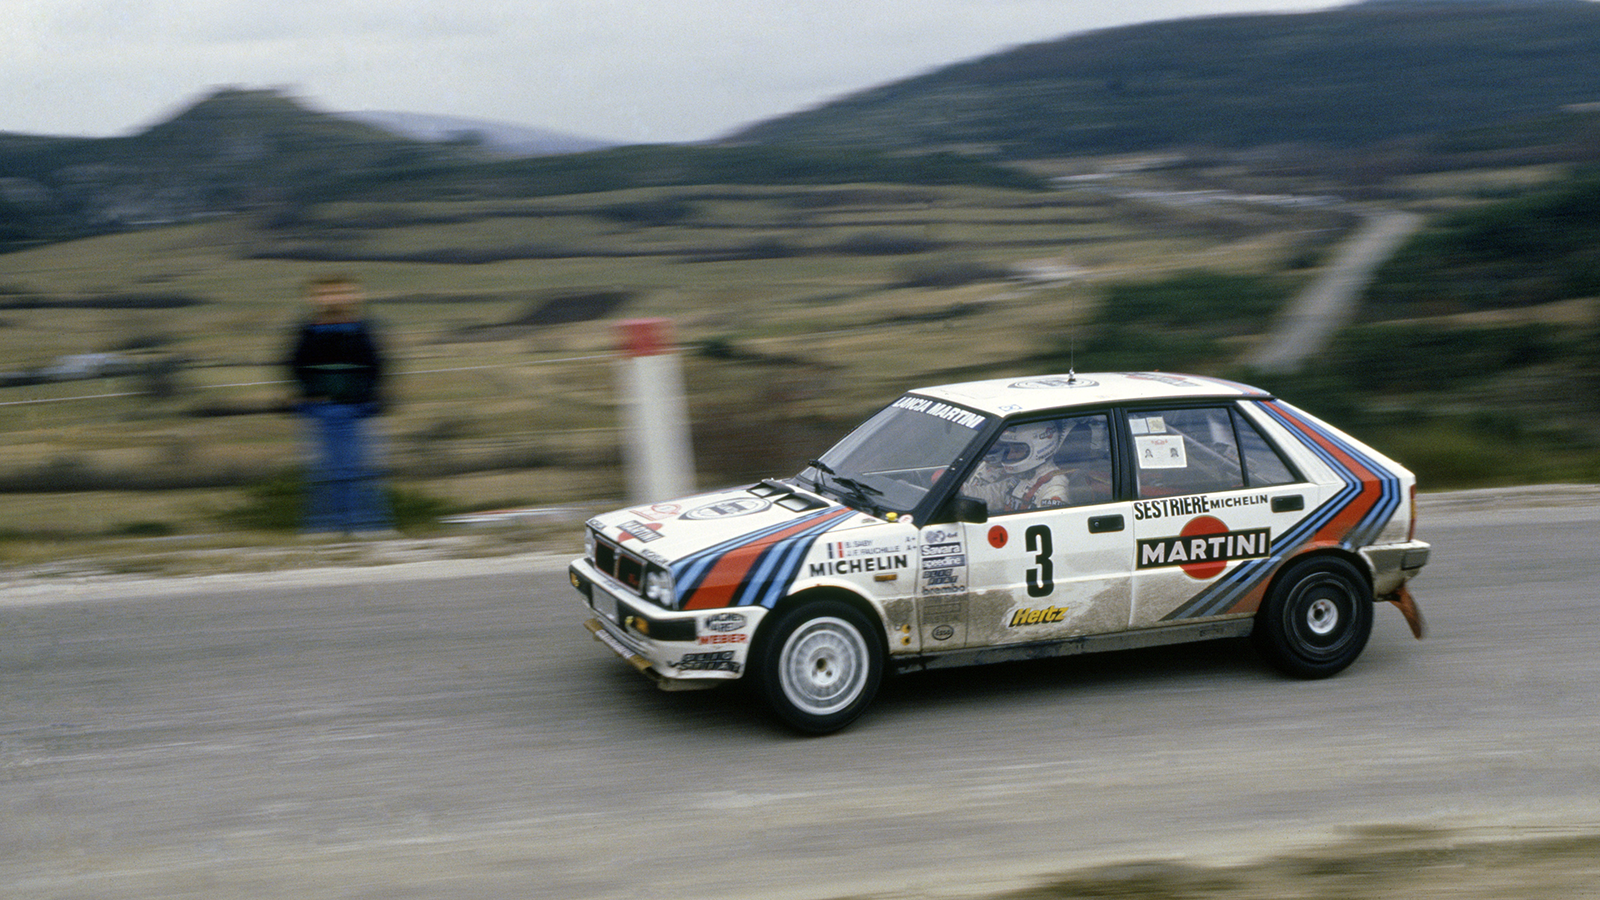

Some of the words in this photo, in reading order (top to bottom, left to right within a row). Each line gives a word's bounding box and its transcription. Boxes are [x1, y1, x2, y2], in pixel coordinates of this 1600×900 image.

[891, 396, 933, 412] LANCIA
[926, 402, 986, 429] MARTINI
[1134, 495, 1210, 520] SESTRIERE
[1210, 494, 1268, 509] MICHELIN
[853, 539, 873, 548] SABY
[922, 544, 960, 555] Savara
[1142, 532, 1266, 566] MARTINI
[809, 554, 907, 577] MICHELIN
[922, 556, 961, 569] speedline
[1025, 524, 1054, 597] 3
[922, 583, 965, 595] brembo
[1008, 605, 1069, 627] Hertz
[697, 633, 747, 645] WEBER
